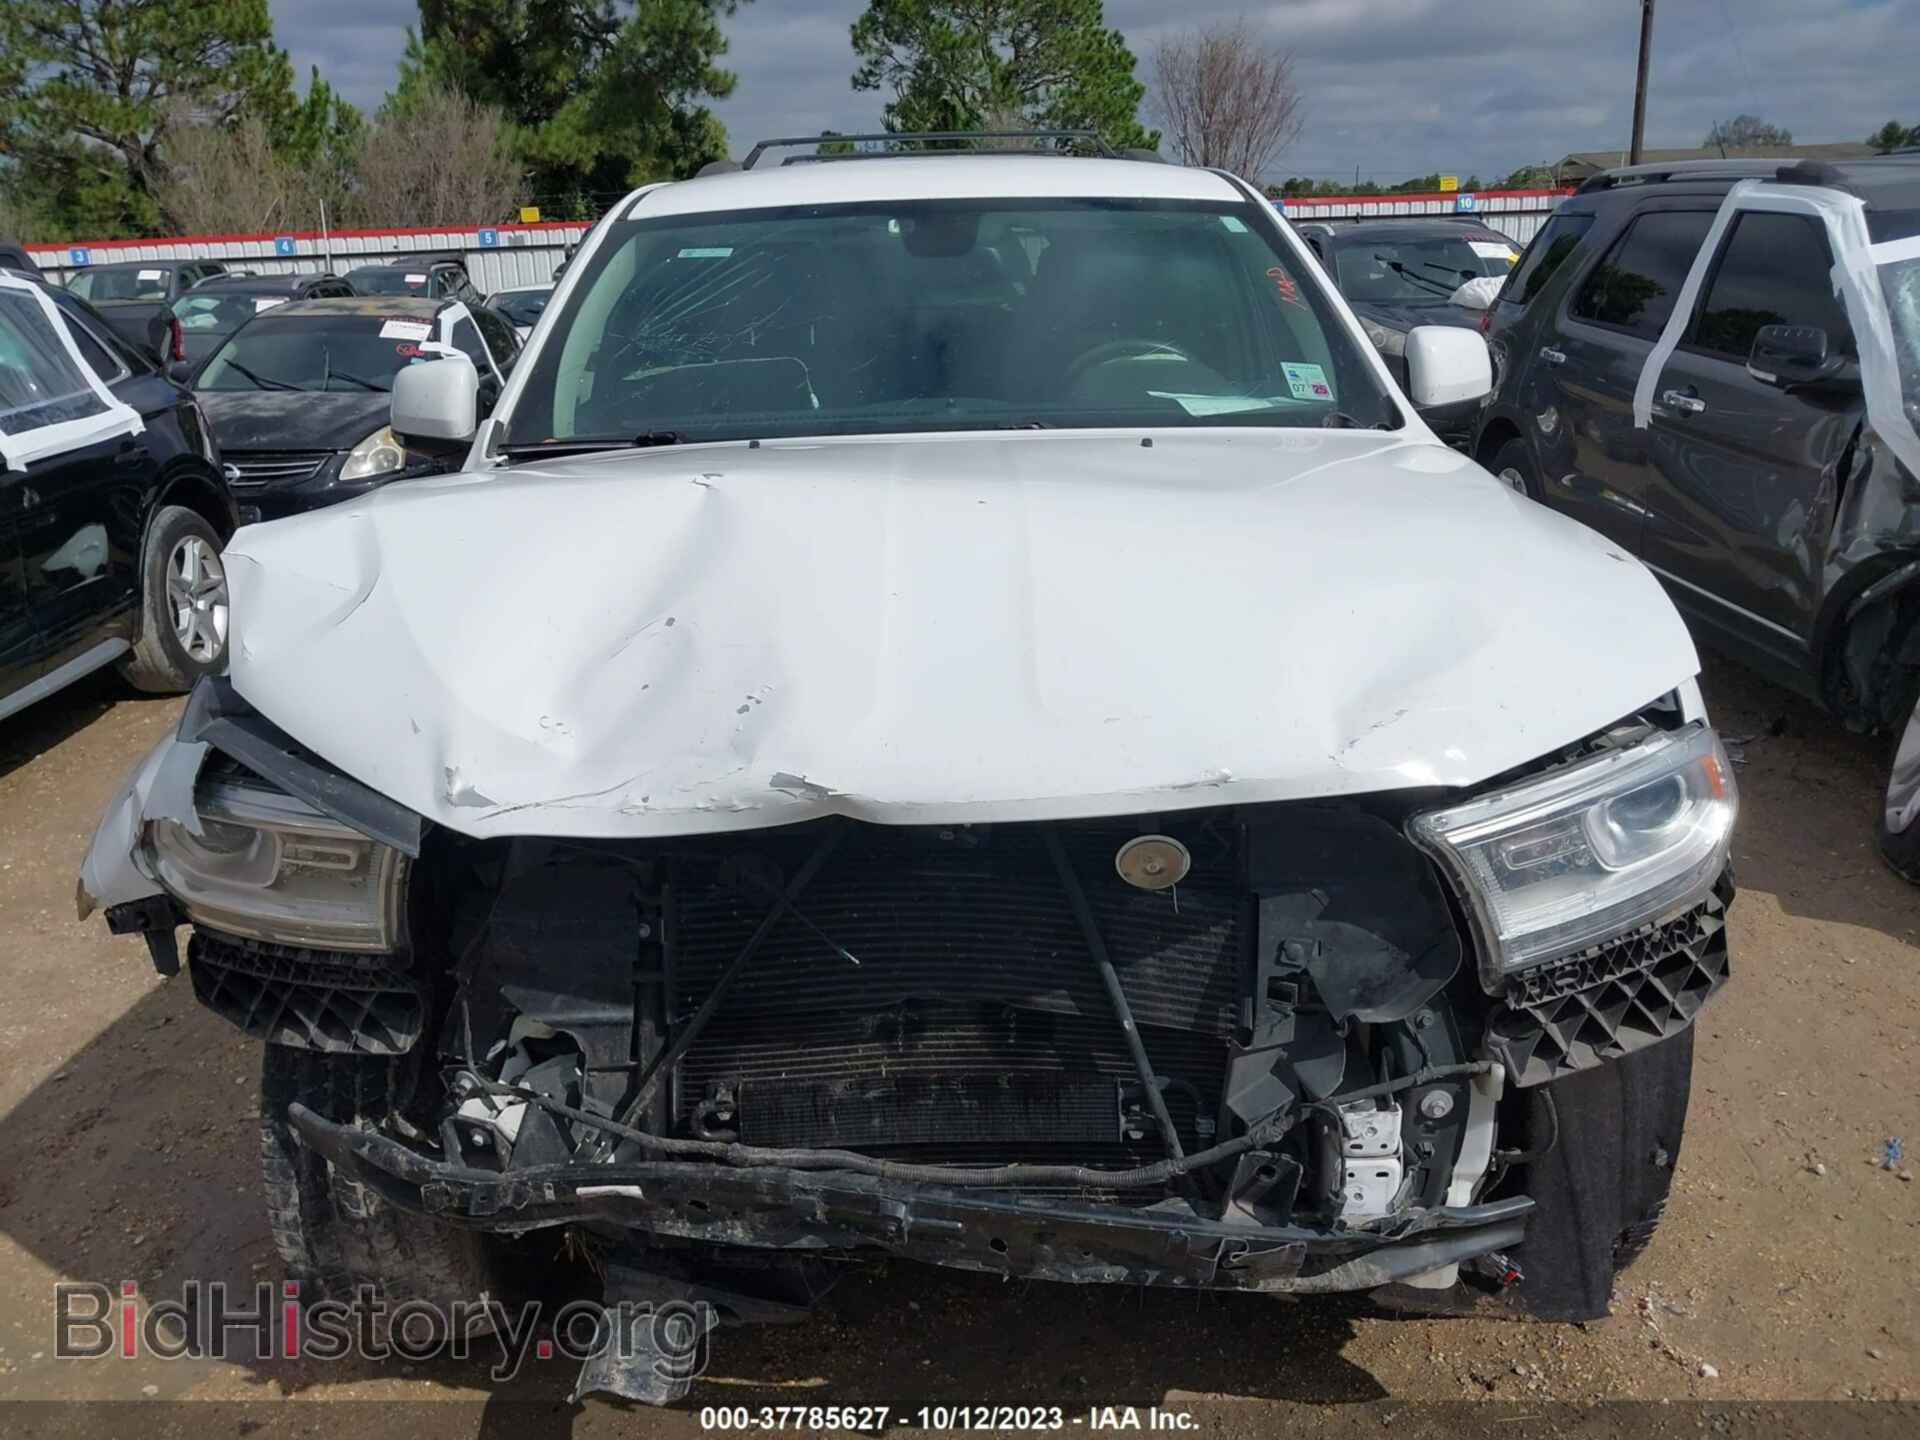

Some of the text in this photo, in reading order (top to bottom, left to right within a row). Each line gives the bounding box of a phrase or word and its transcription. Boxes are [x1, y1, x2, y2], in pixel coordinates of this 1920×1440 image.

[1460, 197, 1473, 209] 10
[485, 232, 492, 244] 5
[281, 240, 289, 252] 4
[76, 251, 84, 262] 3
